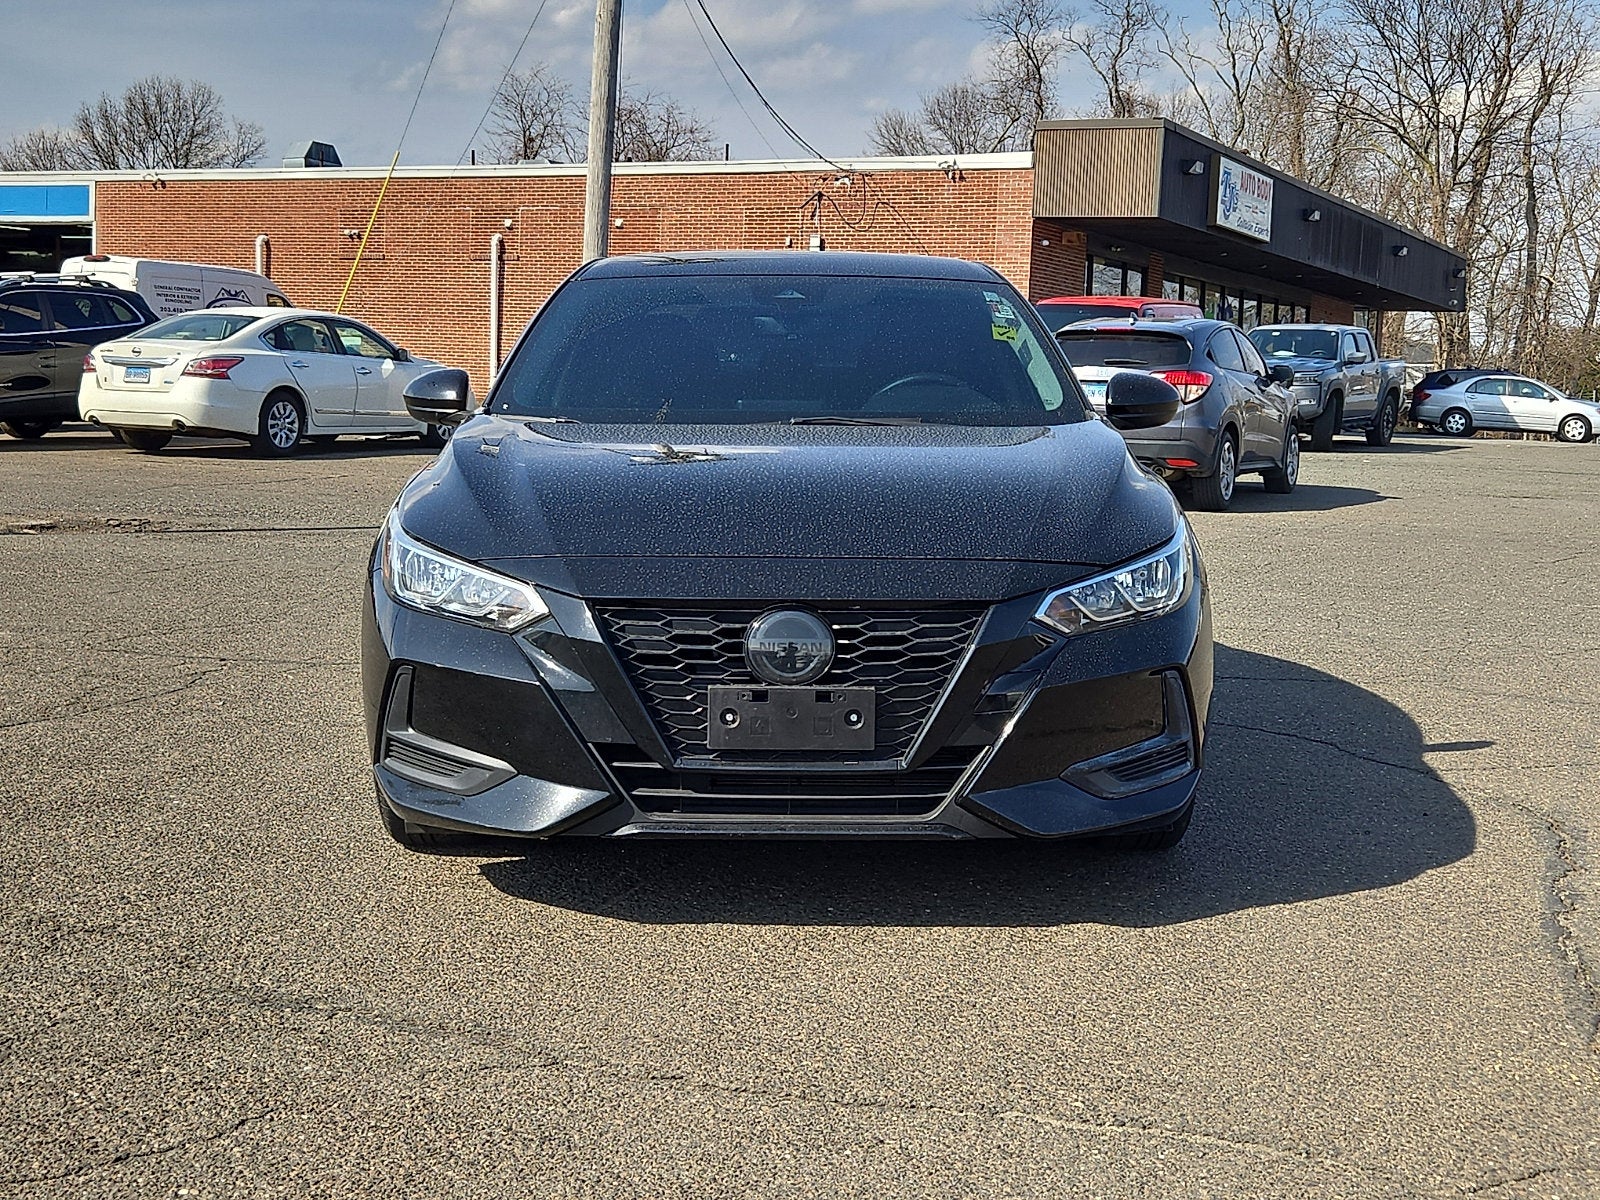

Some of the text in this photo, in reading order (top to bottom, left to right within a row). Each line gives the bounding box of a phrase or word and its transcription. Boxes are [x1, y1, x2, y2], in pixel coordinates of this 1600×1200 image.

[1240, 170, 1272, 202] AUTO BODY
[760, 641, 822, 653] NISSAN
